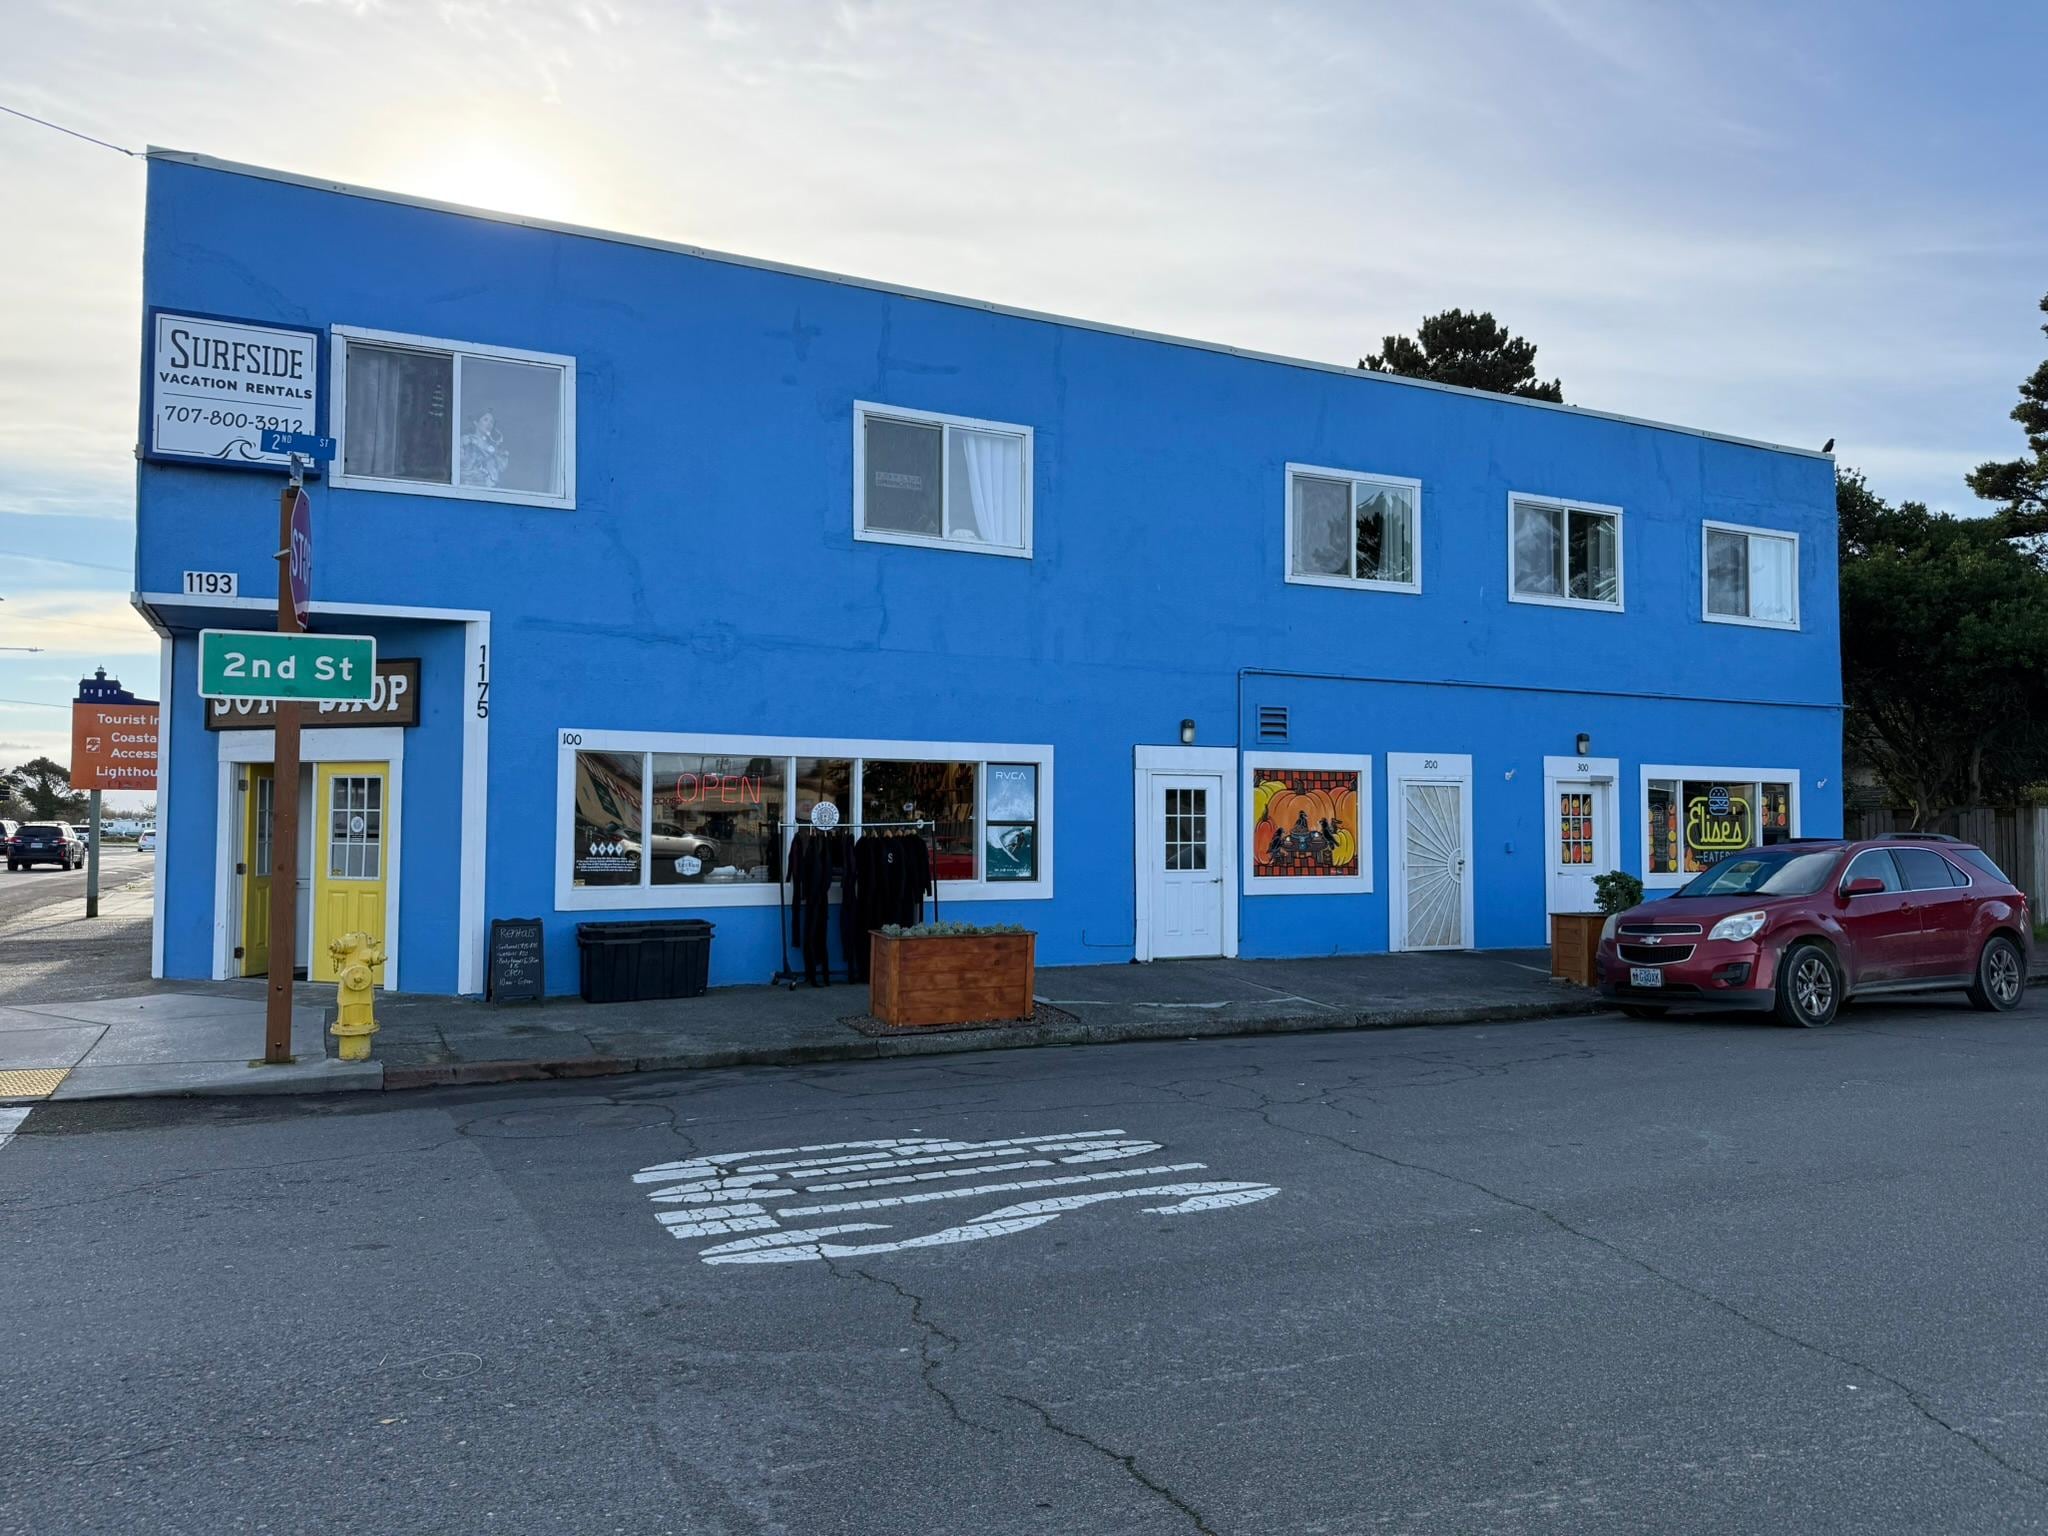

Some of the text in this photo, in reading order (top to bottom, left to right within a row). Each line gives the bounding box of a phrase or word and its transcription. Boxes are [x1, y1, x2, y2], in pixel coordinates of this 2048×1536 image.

[160, 372, 313, 400] VACATION RENTALS
[165, 405, 303, 434] 707-800-3912
[271, 434, 329, 450] 2ND ST
[185, 573, 233, 594] 1193
[223, 652, 353, 681] 2nd St
[476, 644, 489, 719] 1175
[97, 713, 146, 725] Tourist
[563, 733, 582, 746] 100
[111, 748, 158, 759] Access
[1424, 759, 1438, 770] 200
[1576, 762, 1589, 772] 300
[995, 771, 1026, 781] RVCA
[676, 773, 761, 804] OPEN
